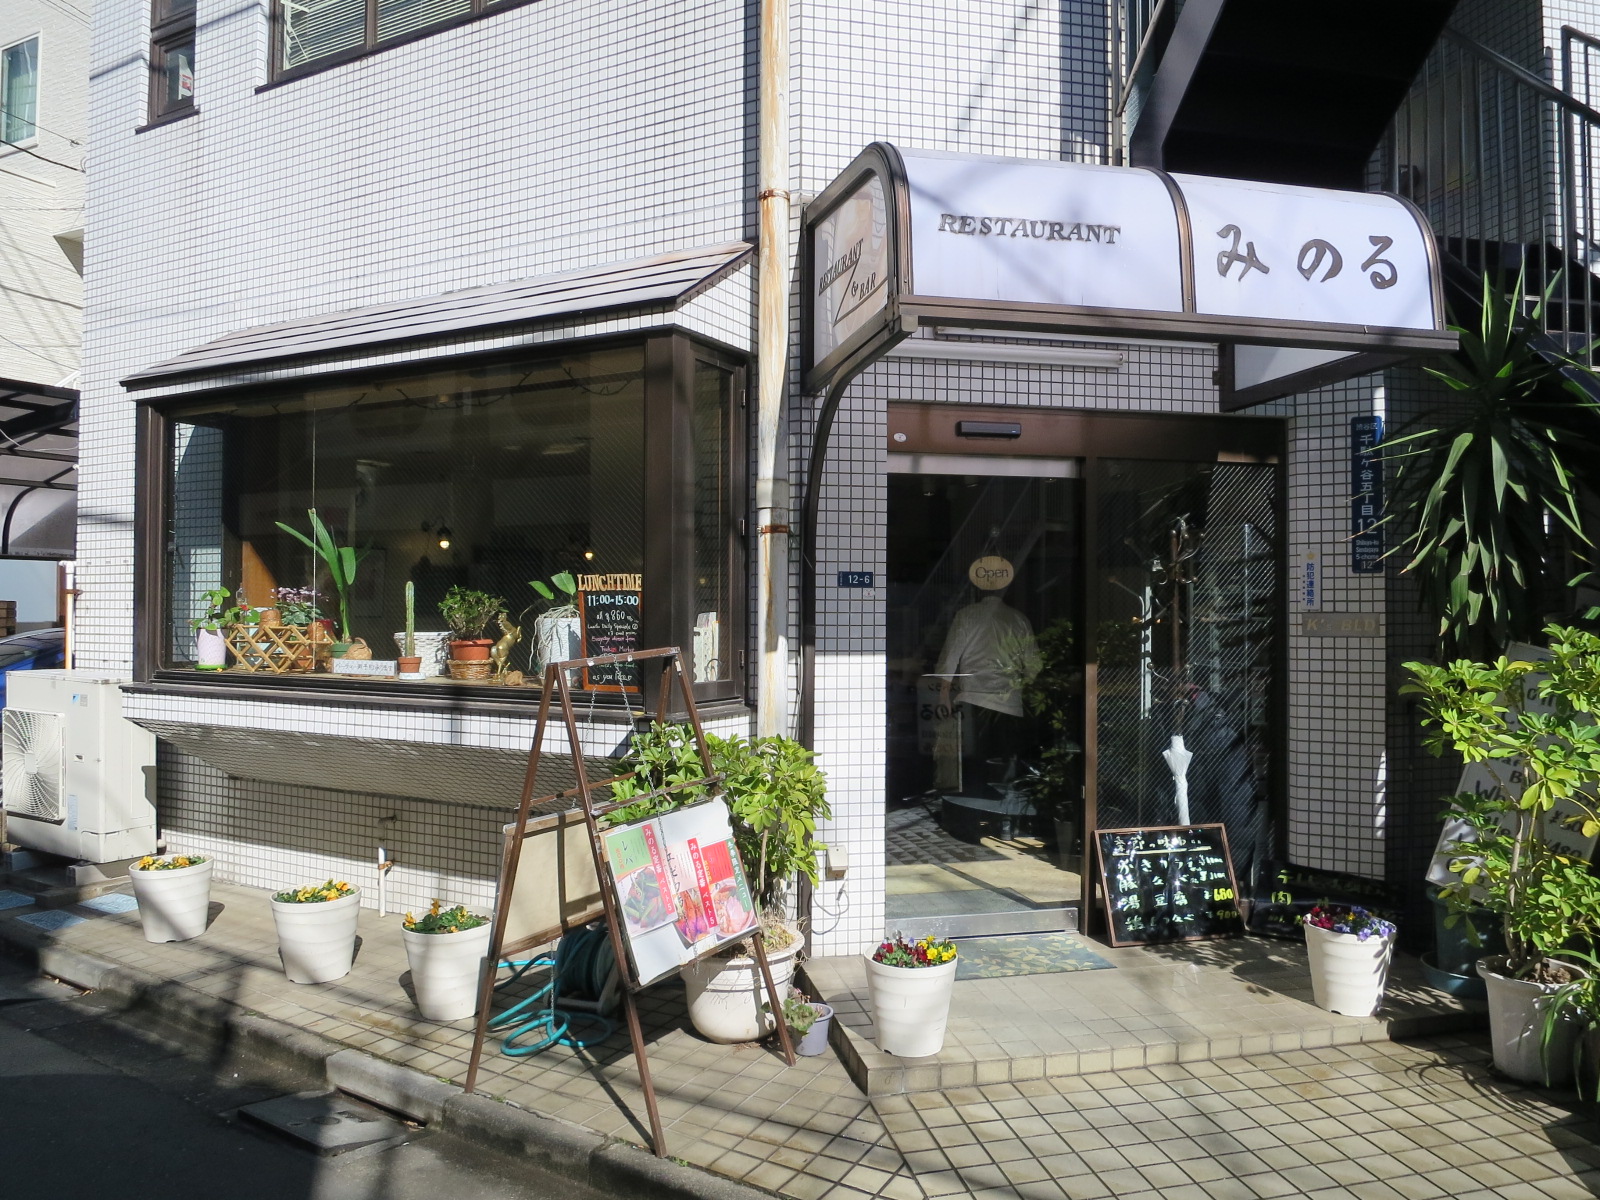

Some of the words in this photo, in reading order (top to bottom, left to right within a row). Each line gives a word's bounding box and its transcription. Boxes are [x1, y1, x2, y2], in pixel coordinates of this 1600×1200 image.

[938, 213, 1121, 246] RESTAURANT
[819, 238, 864, 296] RESTAURANT
[1216, 223, 1399, 290] みのる
[851, 280, 859, 297] &
[859, 272, 876, 301] BAR
[1357, 518, 1377, 534] 12
[848, 574, 871, 584] 12-6
[975, 567, 1009, 582] Open
[1362, 560, 1373, 569] 12
[577, 573, 642, 591] LUNCHTIME
[1306, 562, 1315, 606] 防犯連絡所
[601, 674, 613, 684] you
[644, 827, 663, 874] みのる定番
[689, 842, 706, 887] みのる定番
